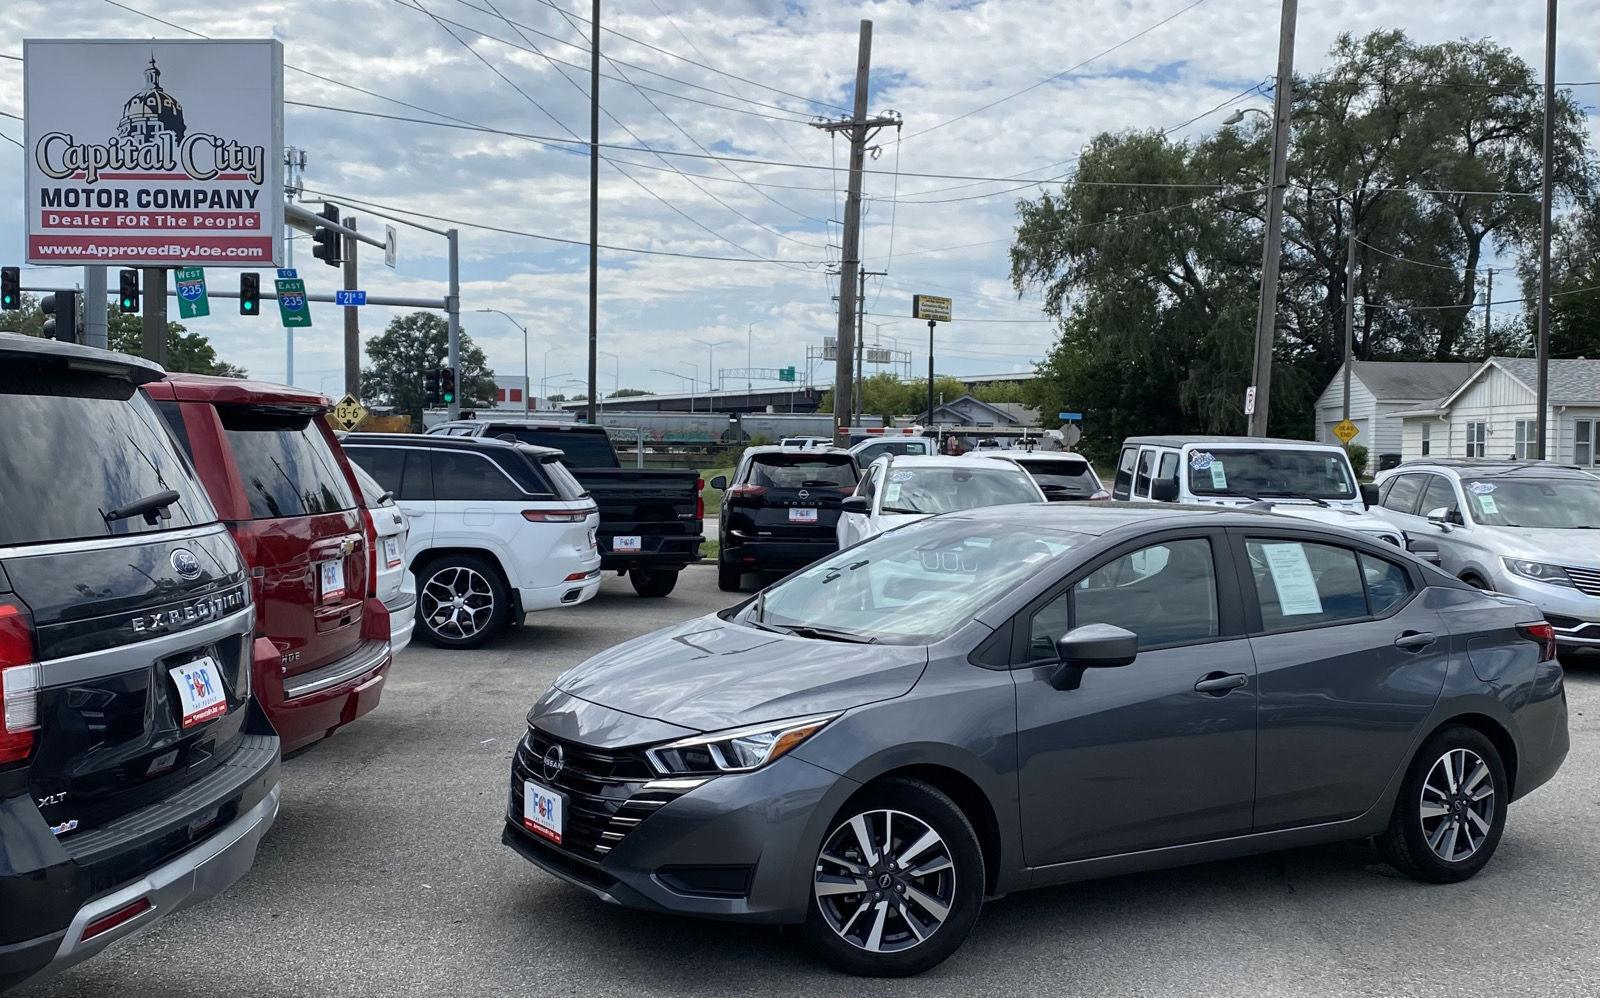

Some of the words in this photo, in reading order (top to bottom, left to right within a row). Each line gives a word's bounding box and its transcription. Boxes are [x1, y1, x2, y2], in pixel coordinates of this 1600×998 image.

[36, 131, 177, 184] Capital
[181, 132, 265, 185] City
[41, 187, 129, 208] MOTOR
[136, 188, 260, 209] COMPANY
[49, 214, 109, 226] Dealer
[116, 215, 150, 226] FOR
[155, 215, 187, 226] The
[38, 244, 262, 257] www.ApprovedByJoe.com
[181, 285, 202, 296] 235
[283, 296, 303, 306] 235
[184, 669, 215, 702] FOR
[38, 791, 67, 808] XLT
[533, 792, 554, 822] FOR
